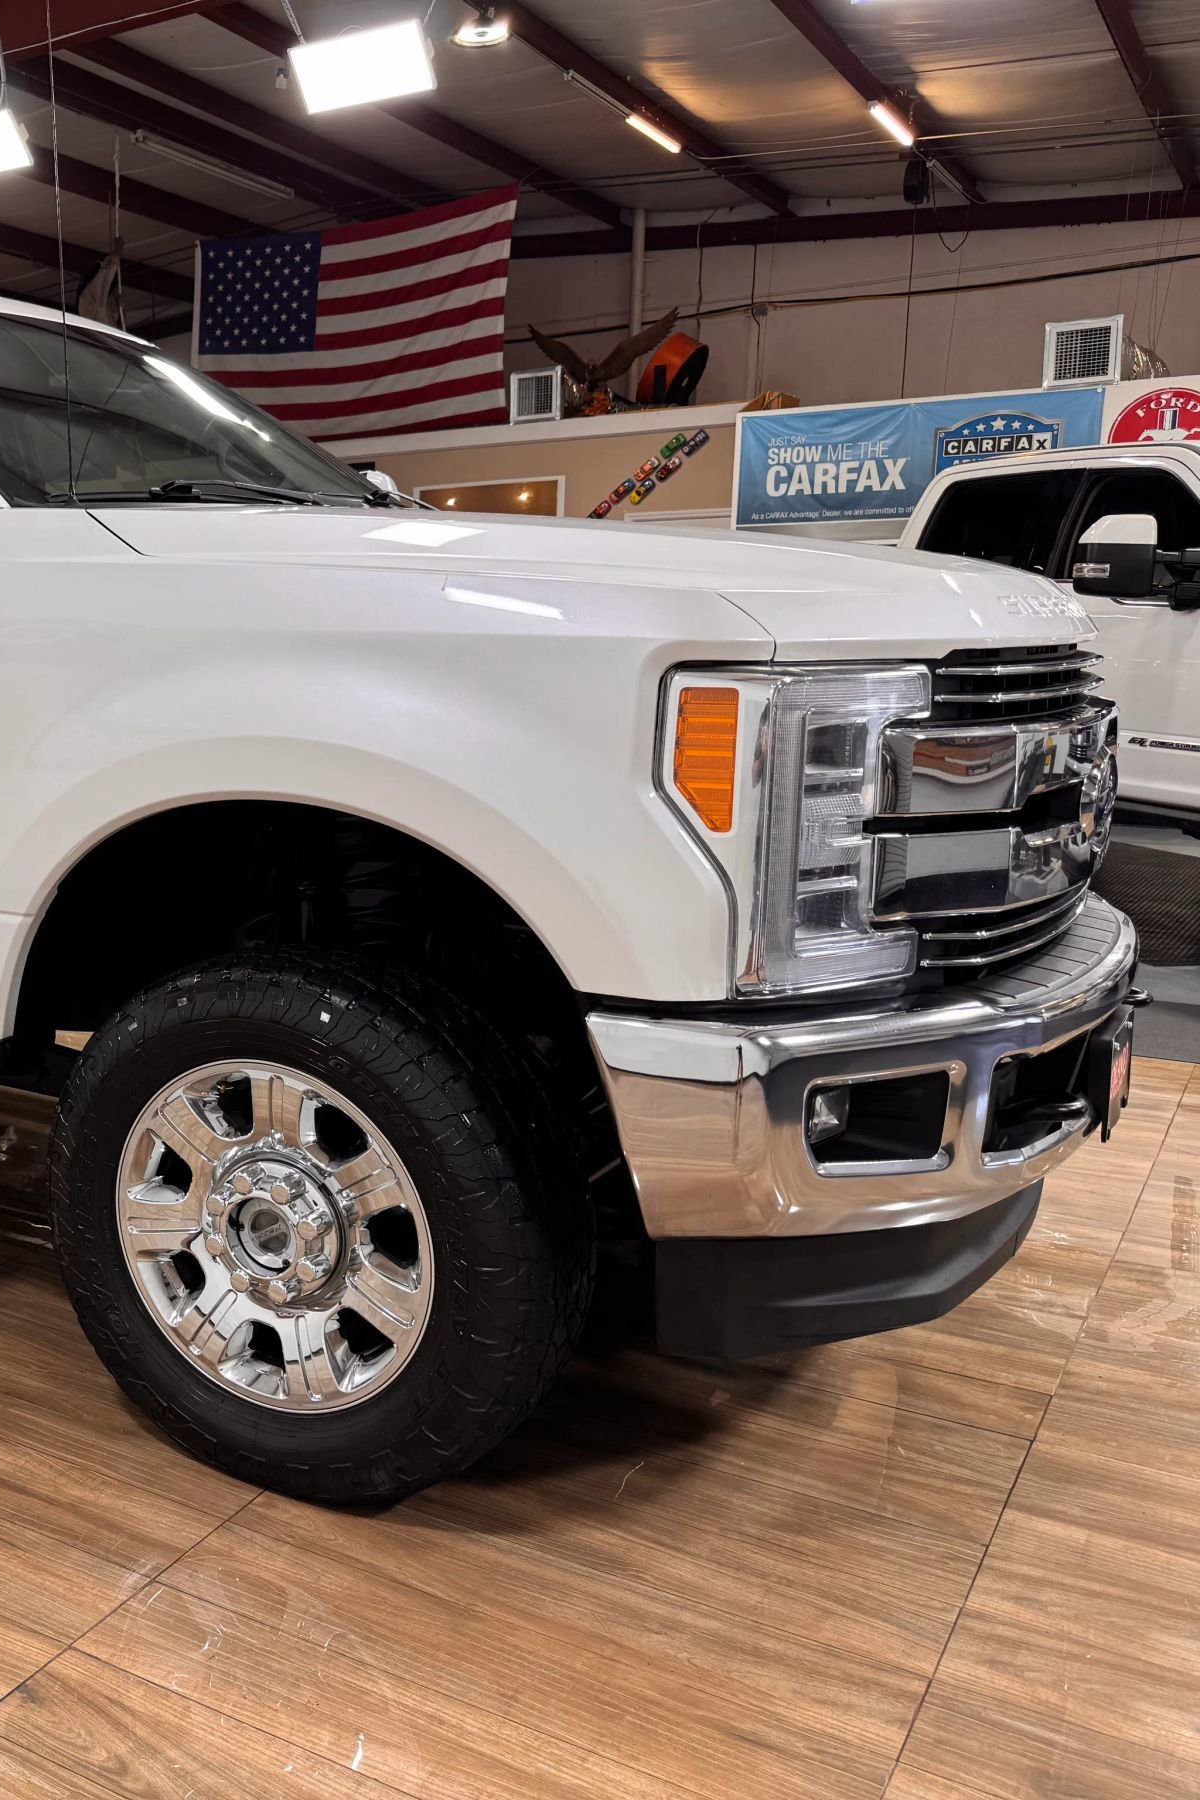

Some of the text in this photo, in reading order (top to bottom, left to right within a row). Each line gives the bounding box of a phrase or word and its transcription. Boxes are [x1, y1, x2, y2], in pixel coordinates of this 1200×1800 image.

[1136, 397, 1200, 418] FORD
[768, 435, 807, 446] JUST SAY
[947, 436, 1049, 454] CARFAX
[767, 440, 889, 465] SHOW ME THE
[766, 457, 907, 497] CARFAX
[751, 512, 760, 520] As
[765, 511, 789, 520] CARFAX
[865, 507, 897, 515] committed
[326, 1055, 421, 1138] OPEN
